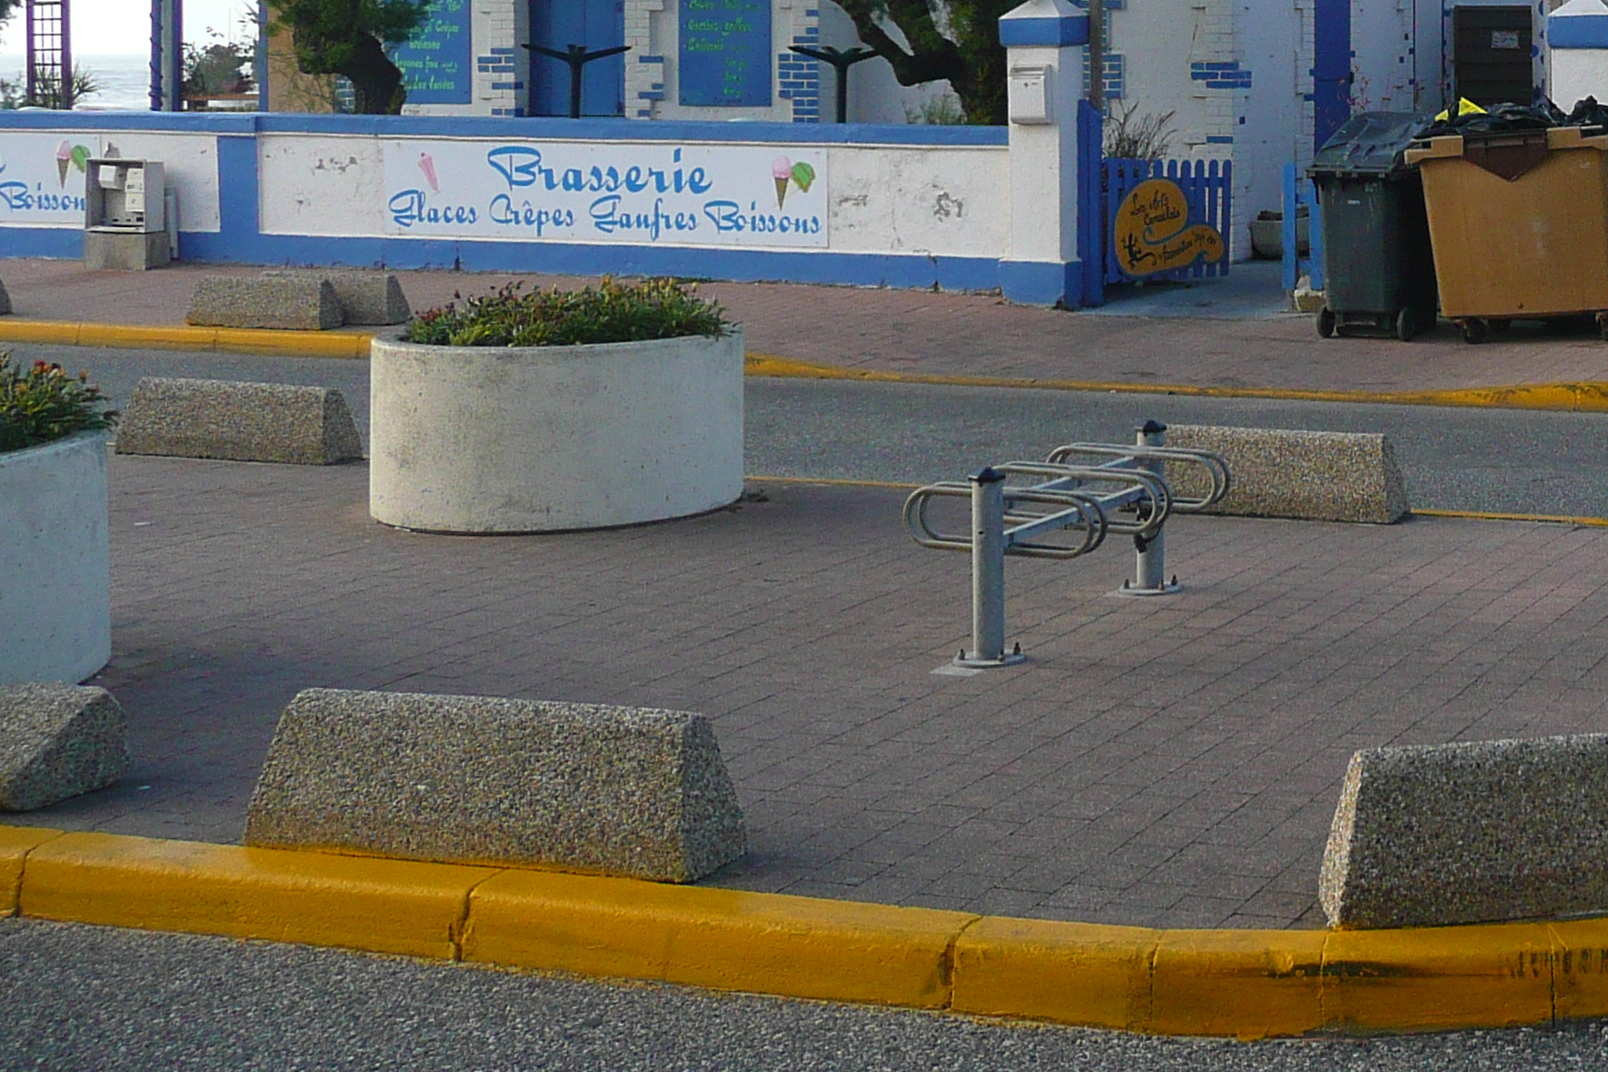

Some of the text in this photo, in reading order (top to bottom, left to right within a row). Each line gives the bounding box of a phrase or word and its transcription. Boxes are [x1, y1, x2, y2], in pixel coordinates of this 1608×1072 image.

[487, 146, 713, 195] Brasserie
[0, 180, 85, 212] Boisson
[388, 189, 821, 242] Glaces Crêpes Gaufres Boissons
